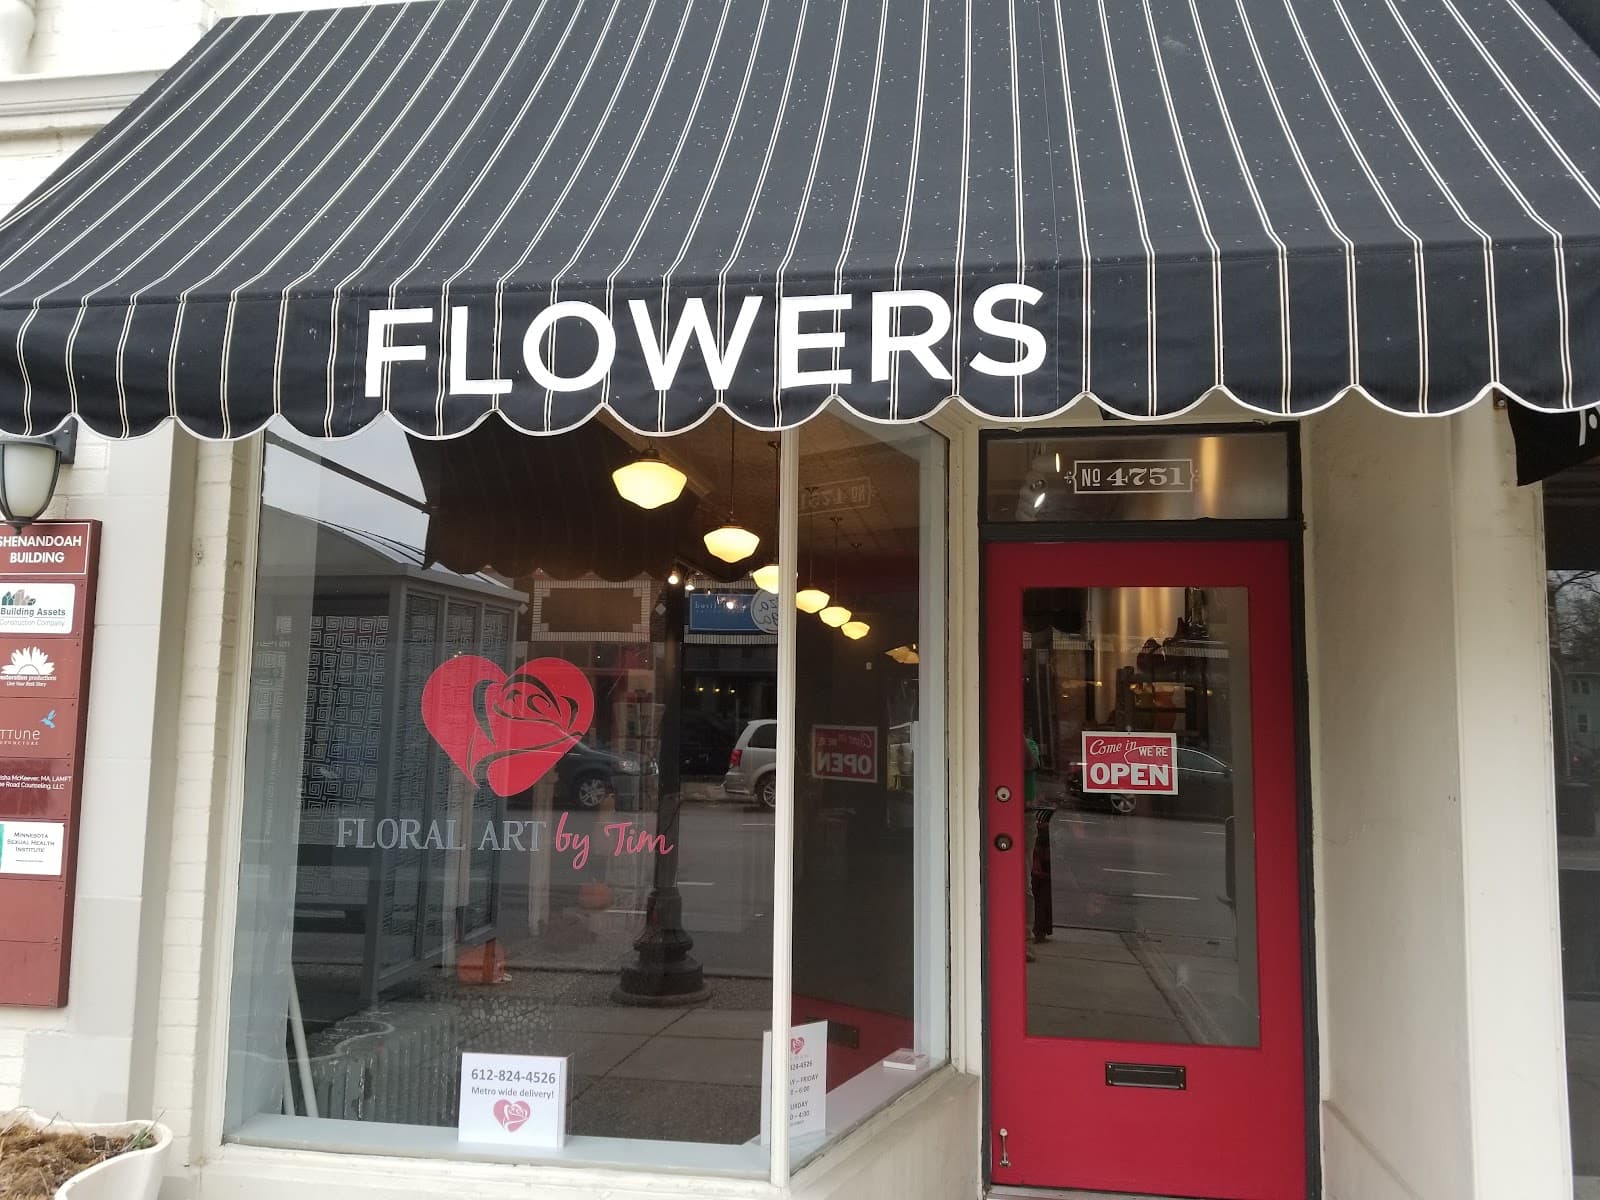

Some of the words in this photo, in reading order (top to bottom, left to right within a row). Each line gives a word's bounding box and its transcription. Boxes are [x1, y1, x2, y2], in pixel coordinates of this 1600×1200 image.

[365, 283, 1047, 397] FLOWERS
[1106, 467, 1184, 486] 4751
[10, 552, 65, 563] BUILDING
[0, 607, 35, 617] Building
[36, 608, 66, 616] Assets
[36, 619, 65, 628] Company
[1089, 740, 1122, 756] Come
[1125, 740, 1137, 751] in
[1090, 763, 1169, 786] OPEN
[336, 818, 466, 850] FLORAL
[478, 819, 546, 851] ART
[556, 811, 590, 870] by
[604, 822, 674, 856] Tim
[471, 1068, 556, 1084] 612-824-4526
[471, 1087, 496, 1095] Metro
[498, 1087, 518, 1096] wide
[519, 1089, 554, 1100] delivery!
